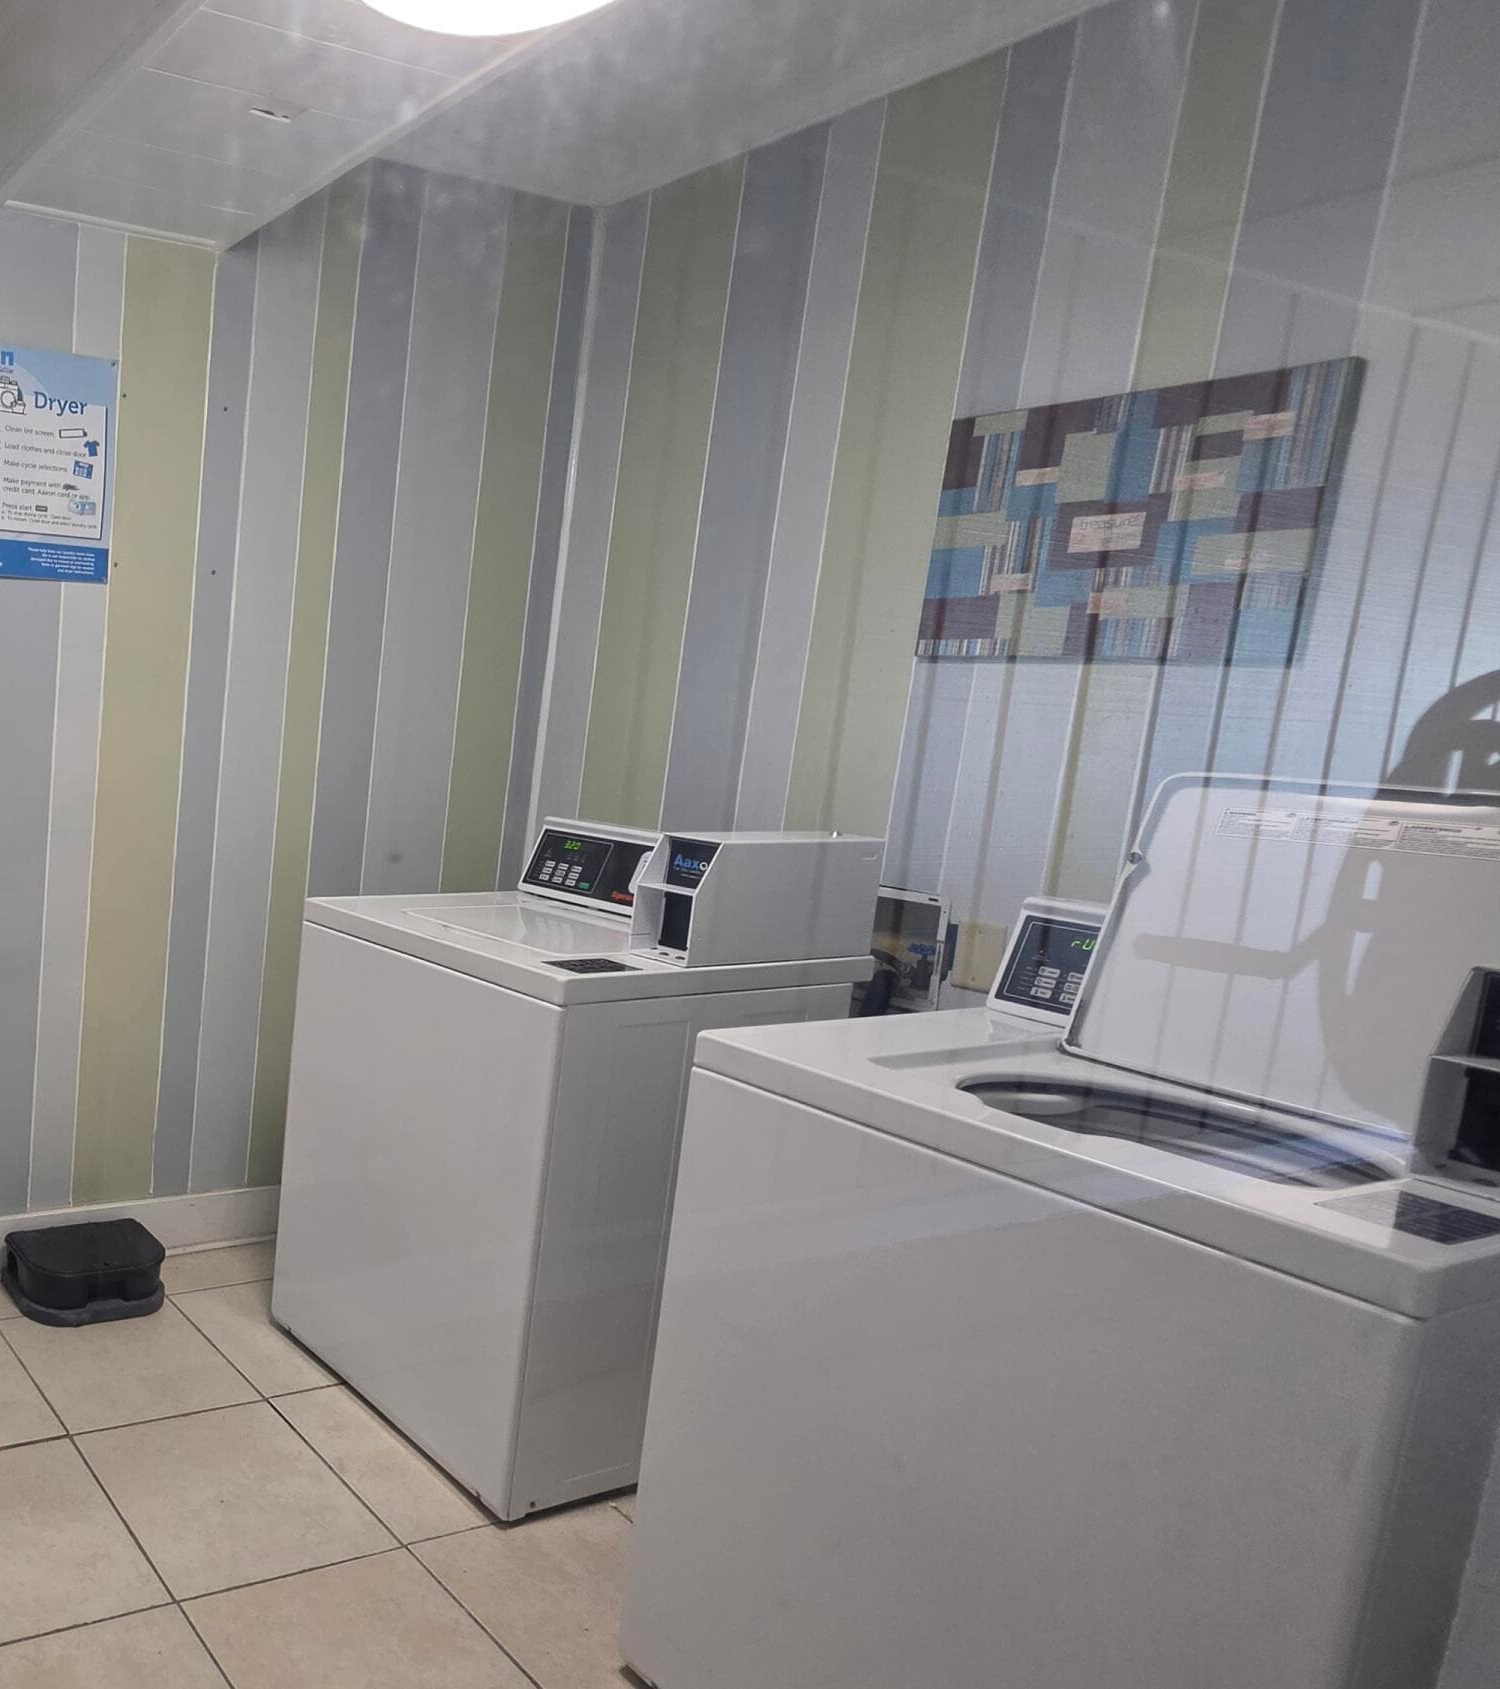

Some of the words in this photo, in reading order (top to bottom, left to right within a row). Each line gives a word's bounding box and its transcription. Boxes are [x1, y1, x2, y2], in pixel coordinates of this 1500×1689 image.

[34, 391, 88, 416] Dryer
[21, 444, 42, 453] clothes
[21, 462, 37, 471] cycle
[20, 479, 47, 487] payment
[2, 502, 17, 510] Press
[674, 854, 708, 871] Aaxo
